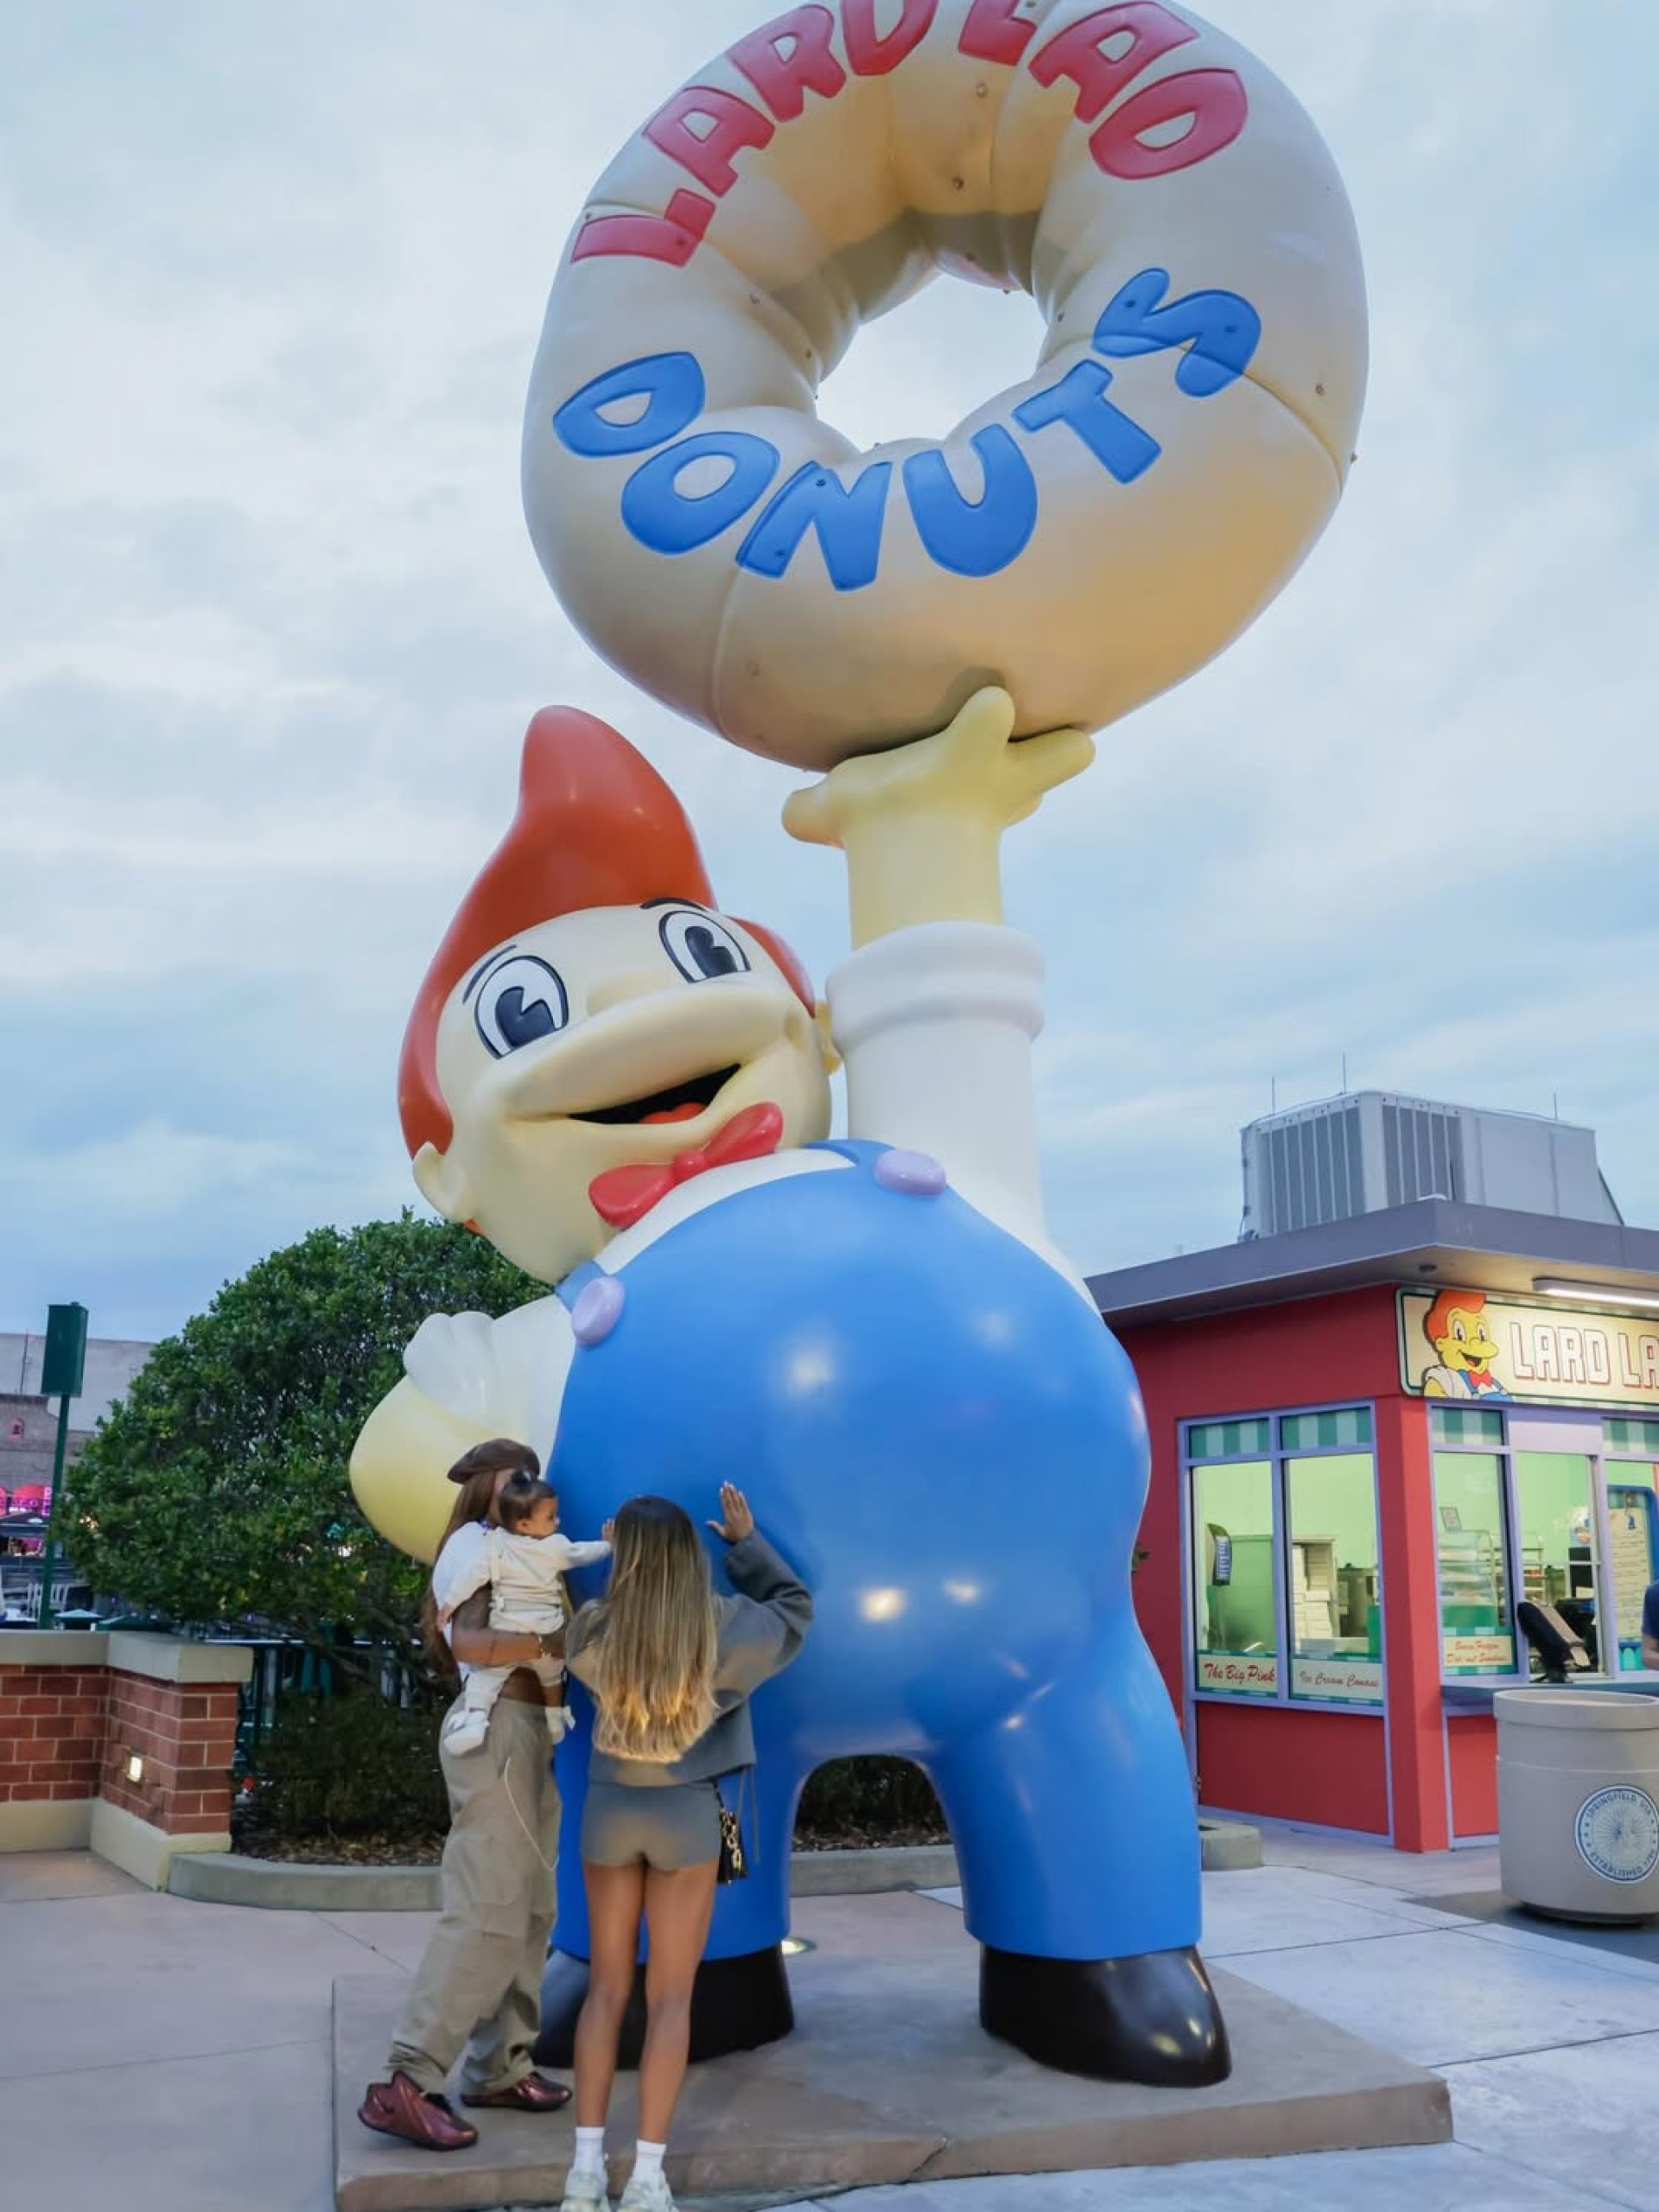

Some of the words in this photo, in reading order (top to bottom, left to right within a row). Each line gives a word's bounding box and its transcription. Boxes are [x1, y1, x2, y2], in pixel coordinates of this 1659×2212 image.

[570, 0, 938, 267] LARD
[552, 268, 1262, 592] DONUTS
[1510, 1322, 1611, 1385] LARD
[1204, 1662, 1224, 1680] The
[1225, 1664, 1245, 1685] Big
[1247, 1664, 1276, 1683] Pink
